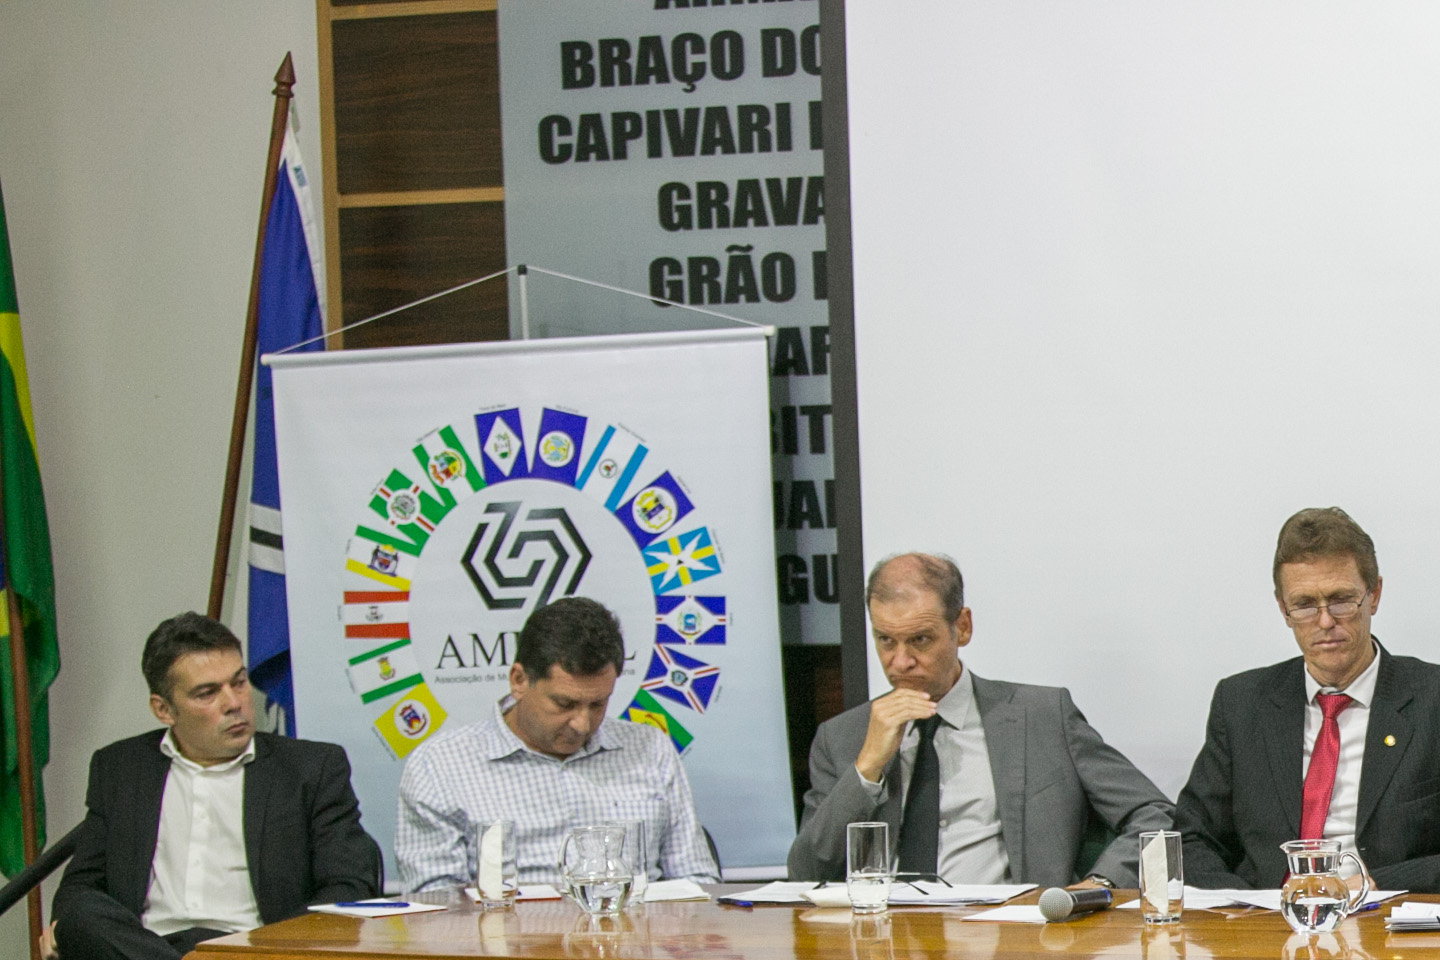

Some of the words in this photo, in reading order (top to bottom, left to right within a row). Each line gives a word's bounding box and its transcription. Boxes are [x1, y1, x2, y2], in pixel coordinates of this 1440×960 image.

[560, 30, 745, 93] BRAÇO
[760, 24, 822, 78] DO
[537, 102, 793, 165] CAPIVARI
[657, 176, 826, 232] GRAVA
[649, 244, 797, 308] GRÃO
[770, 404, 832, 455] IT
